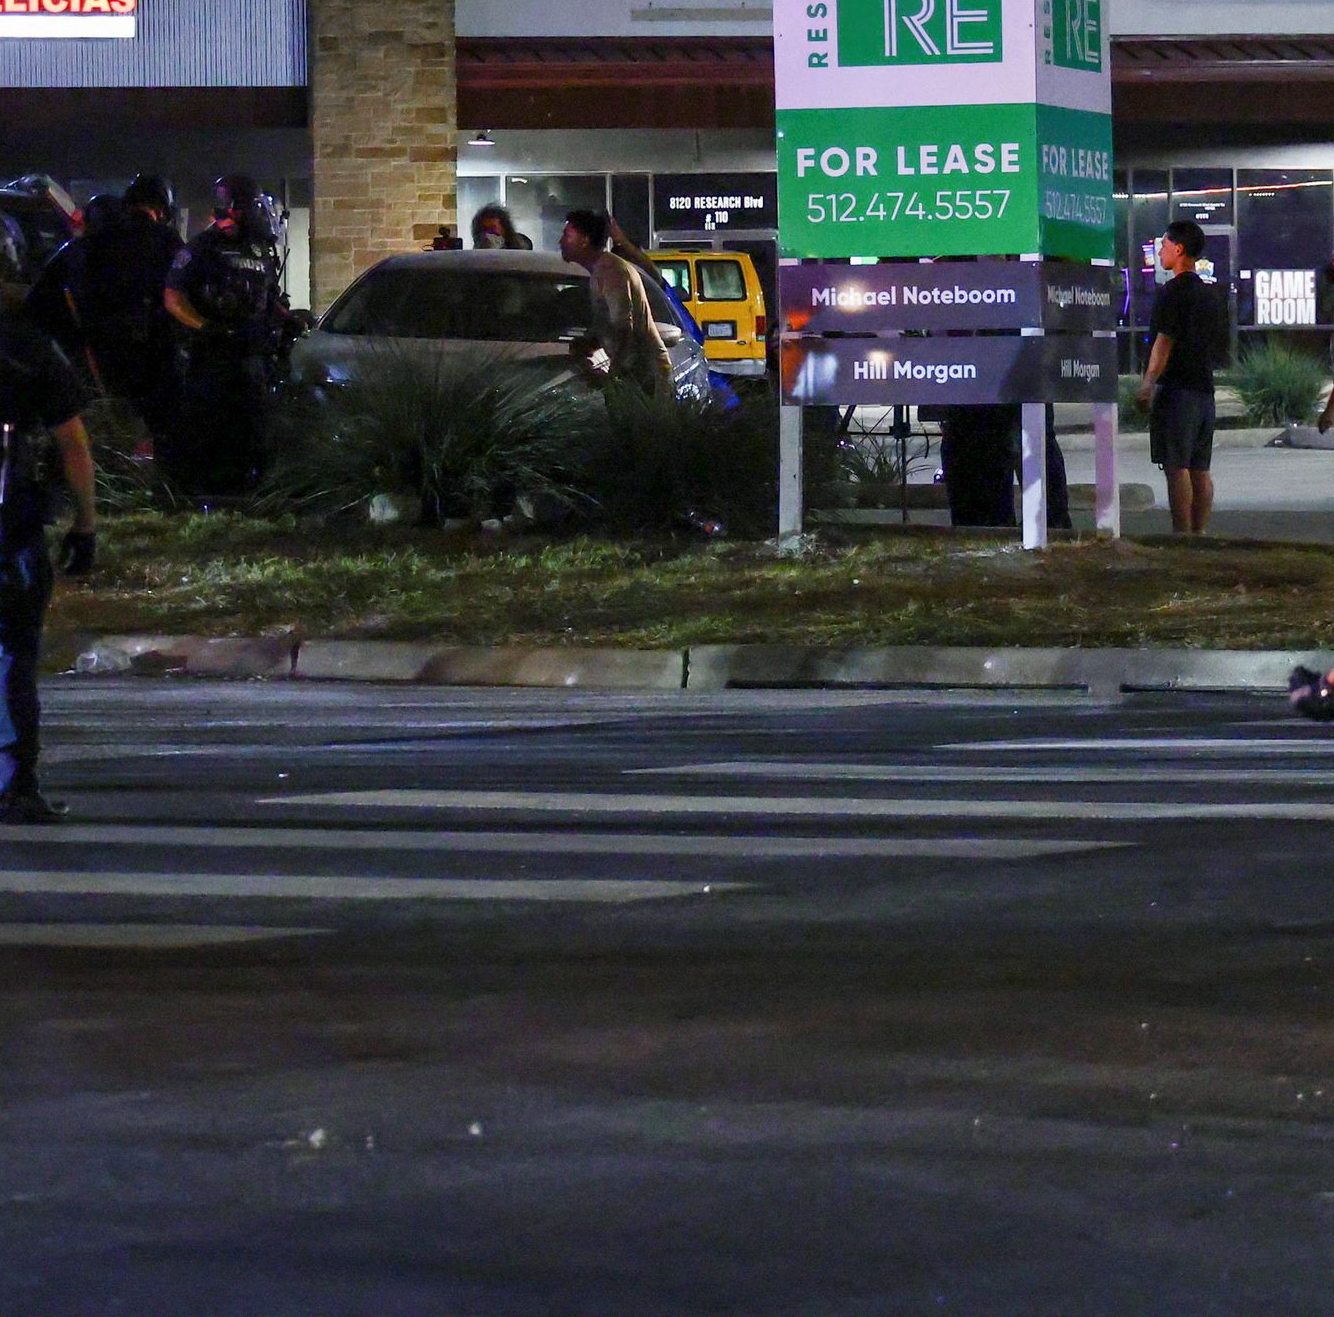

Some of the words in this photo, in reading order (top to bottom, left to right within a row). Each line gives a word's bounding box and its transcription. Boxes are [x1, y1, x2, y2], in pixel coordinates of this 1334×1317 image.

[796, 146, 878, 178] FOR
[897, 143, 1021, 176] LEASE
[1042, 144, 1067, 177] FOR
[1071, 148, 1109, 181] LEASE
[669, 196, 691, 209] 8120
[694, 196, 742, 209] RESEARCH
[744, 195, 764, 209] Blvd
[807, 190, 1011, 223] 512.474.5557
[811, 286, 896, 307] Michael
[903, 285, 1016, 306] Noteboom
[1255, 270, 1315, 298] GAME
[1257, 298, 1316, 325] ROOM
[853, 360, 887, 380] Hill
[893, 360, 977, 384] Morgan
[1073, 359, 1100, 383] Morgan
